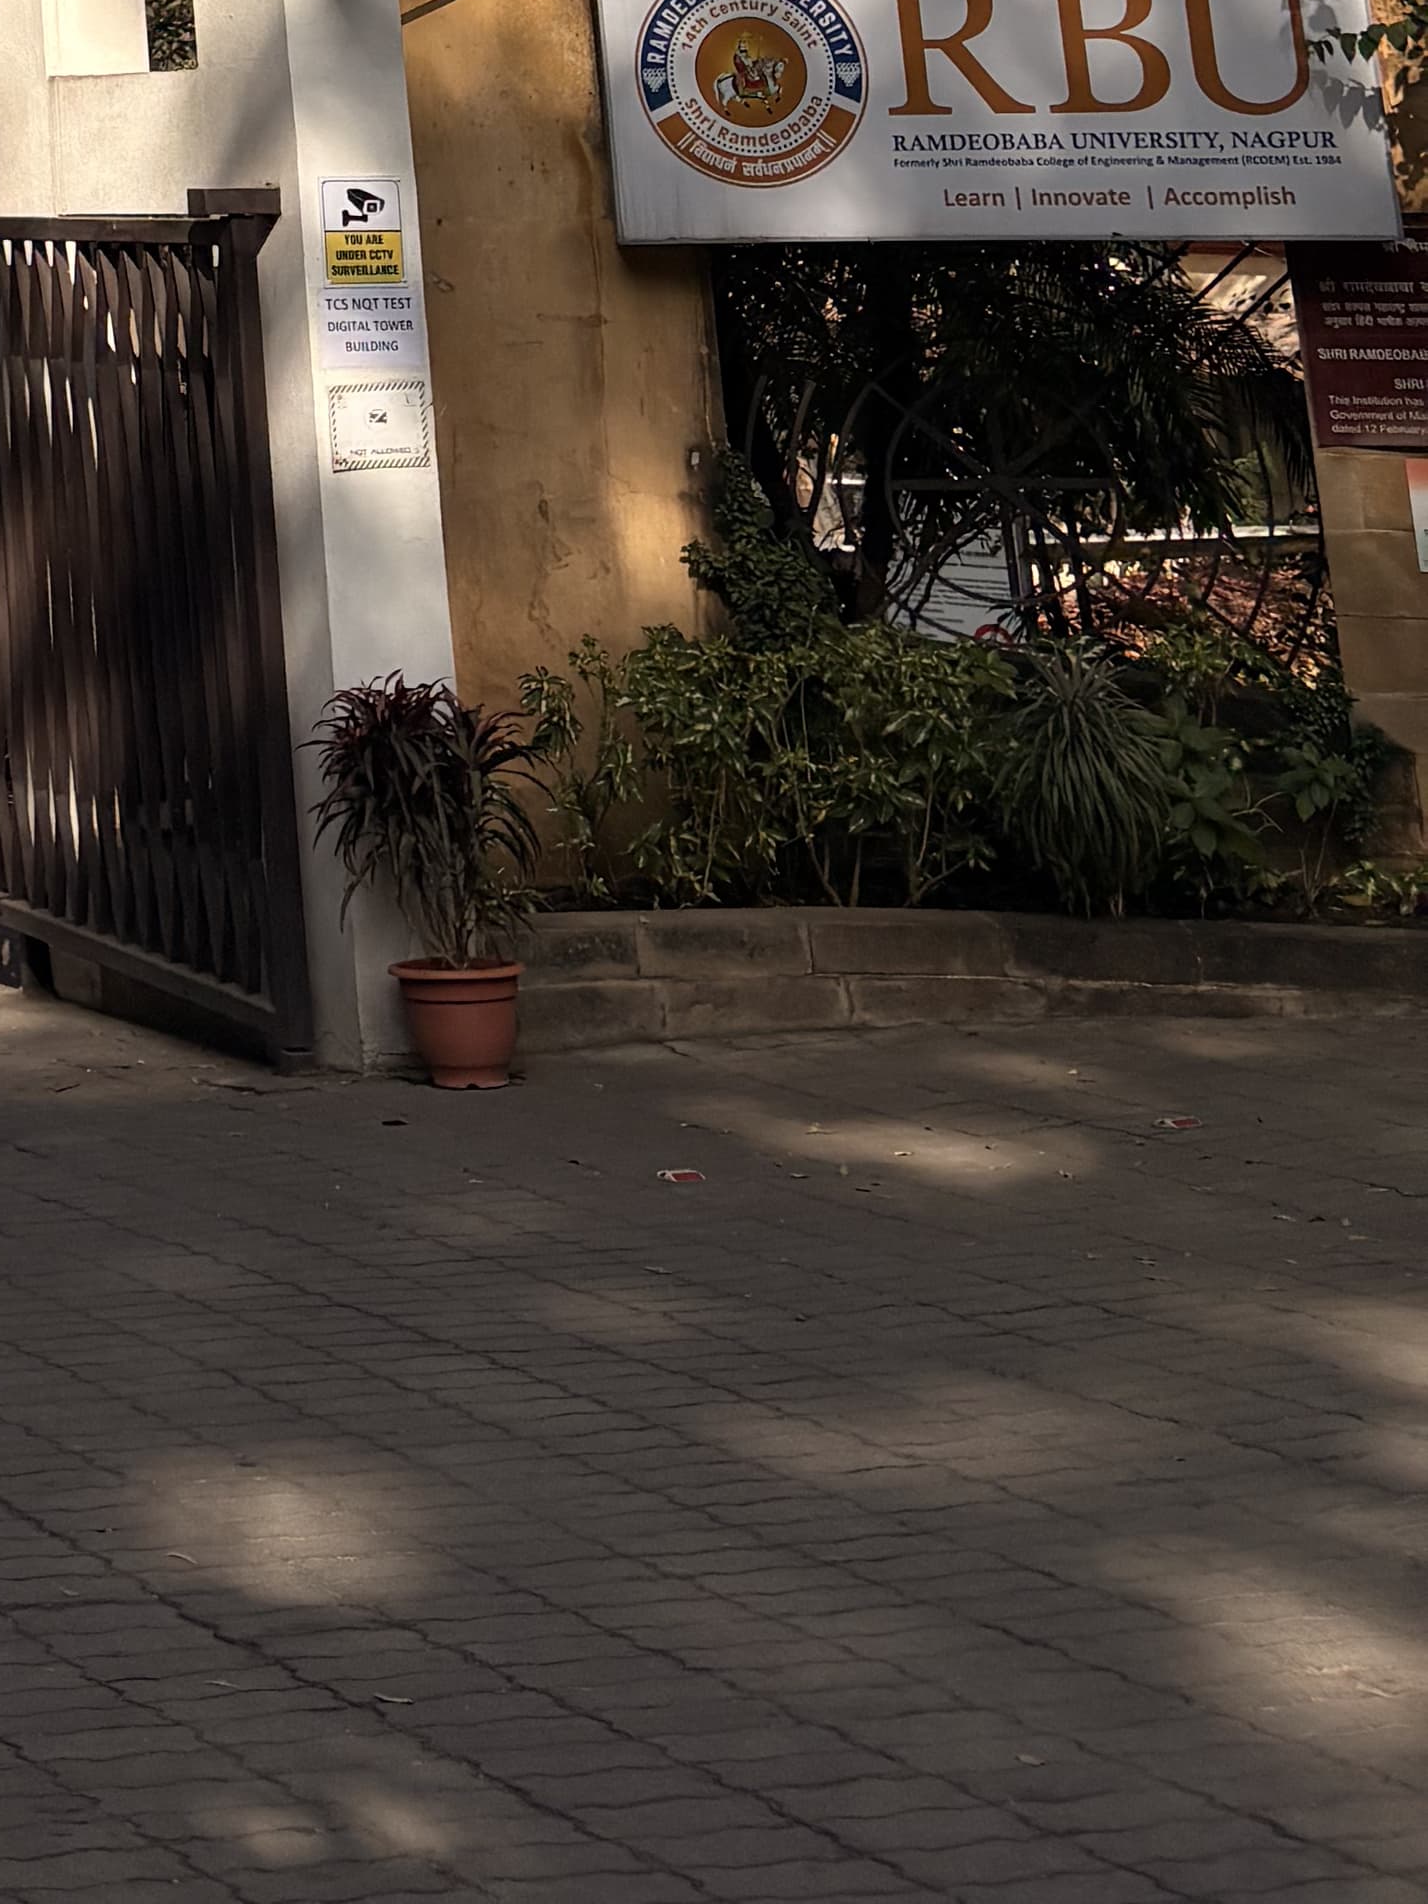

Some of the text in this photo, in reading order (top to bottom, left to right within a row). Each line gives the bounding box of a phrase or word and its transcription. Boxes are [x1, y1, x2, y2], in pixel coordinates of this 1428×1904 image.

[681, 16, 709, 51] 14th
[684, 94, 824, 148] Shri Ramdeobaba
[892, 130, 1339, 153] RAMDEOBABA UNIVERSITY, NAGPUR
[893, 158, 940, 169] Formerly
[942, 157, 963, 168] Shri
[965, 157, 1034, 168] Ramdeobaba
[1036, 156, 1075, 169] College
[1077, 155, 1089, 167] of
[1091, 155, 1154, 168] Engineering
[1167, 155, 1239, 168] Management
[1241, 155, 1290, 167] (RCOEM)
[944, 188, 1005, 207] Learn
[1032, 188, 1131, 207] Innovate
[1164, 186, 1297, 210] Accomplish
[344, 234, 384, 246] YOU ARE
[336, 249, 394, 260] UNDER CCTV
[331, 264, 400, 276] SURVEILLANCE
[325, 297, 412, 311] TCS NQT TEST
[328, 319, 413, 332] DIGITAL TOWER
[345, 340, 399, 352] BUILDING
[1317, 348, 1347, 360] SHRI
[1394, 378, 1424, 390] SHRI
[1329, 409, 1393, 420] Government
